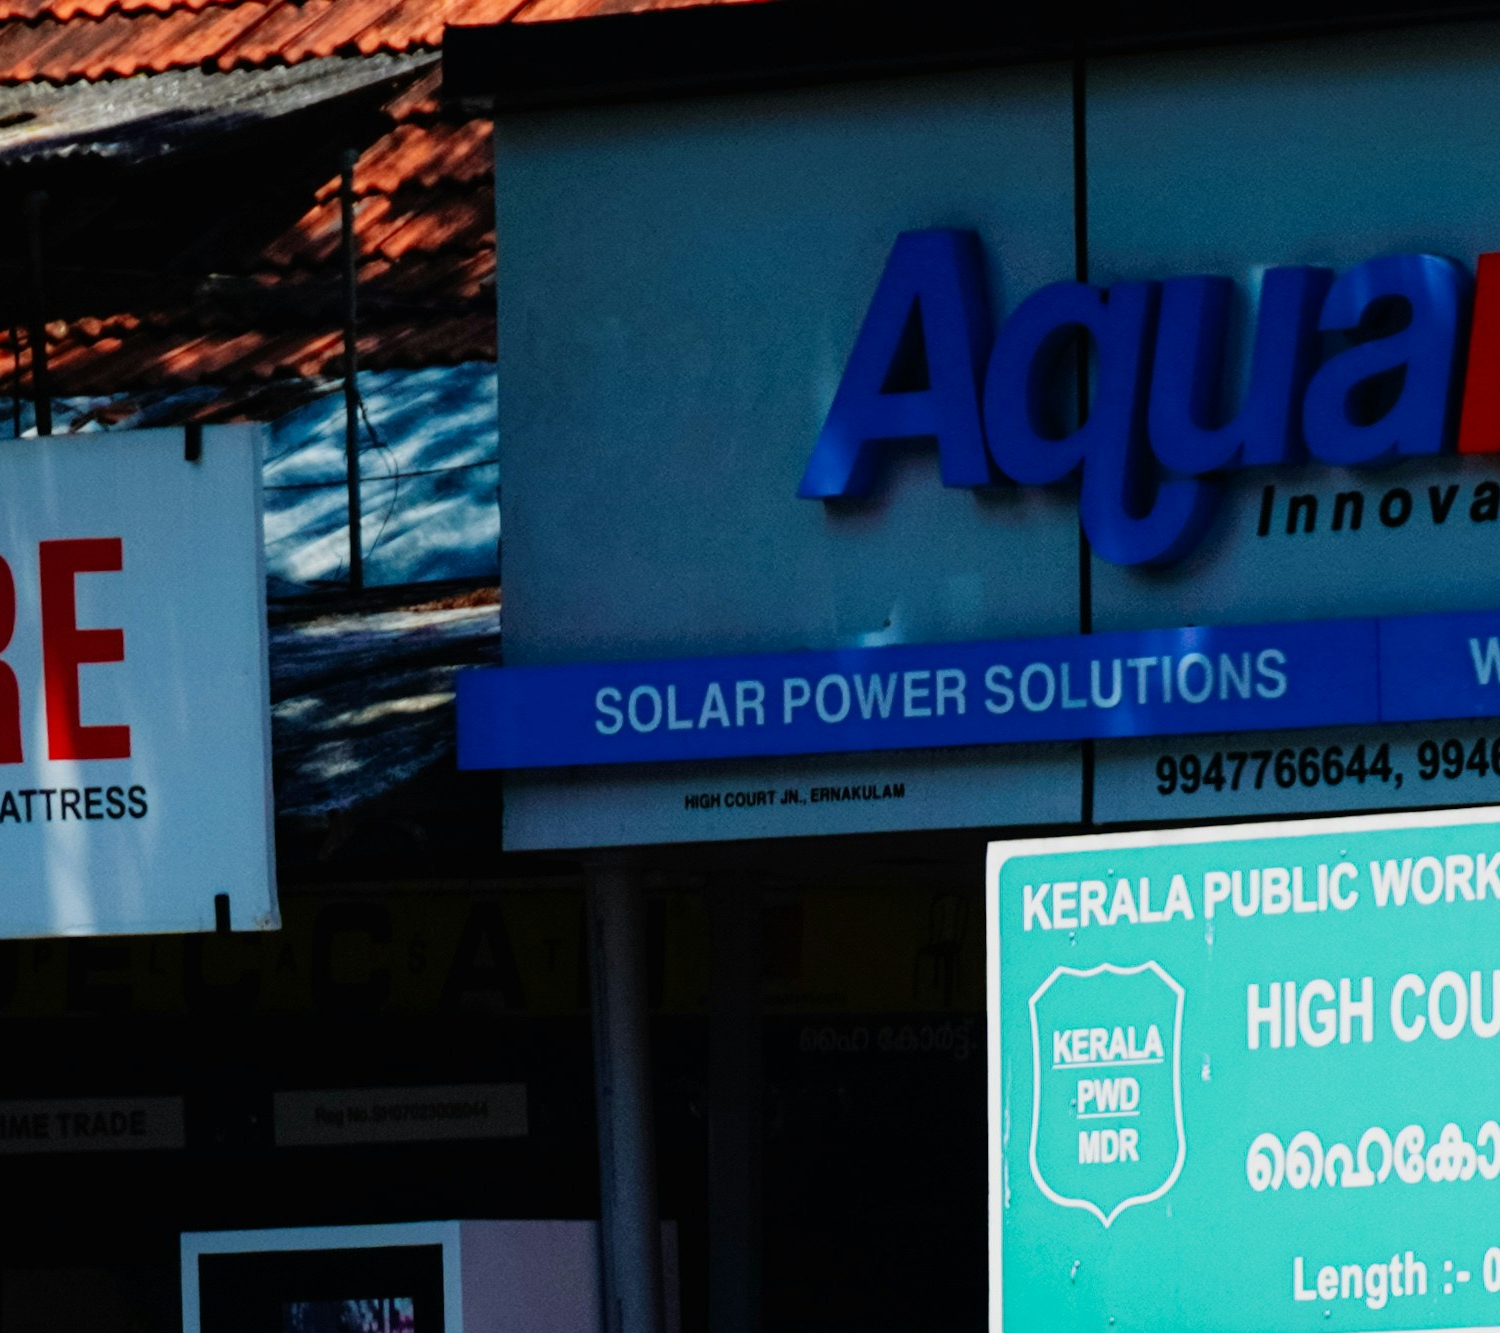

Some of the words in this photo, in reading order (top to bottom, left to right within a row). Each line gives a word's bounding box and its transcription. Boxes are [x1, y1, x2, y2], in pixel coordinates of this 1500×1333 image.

[596, 681, 764, 734] SOLAR
[784, 670, 965, 723] POWER
[985, 649, 1286, 713] SOLUTIONS
[1155, 749, 1403, 798] 9947766644,
[684, 793, 721, 810] HIGH
[724, 790, 776, 808] COURT
[810, 783, 905, 803] ERNAKULAM
[1024, 875, 1193, 931] KERALA
[1205, 862, 1358, 919] PUBLIC
[1248, 977, 1373, 1049] HIGH
[1053, 1024, 1163, 1063] KERALA
[1078, 1077, 1139, 1115] PWD
[55, 1109, 147, 1139] TRADE
[1079, 1129, 1138, 1163] MDR
[1294, 1251, 1426, 1309] Length
